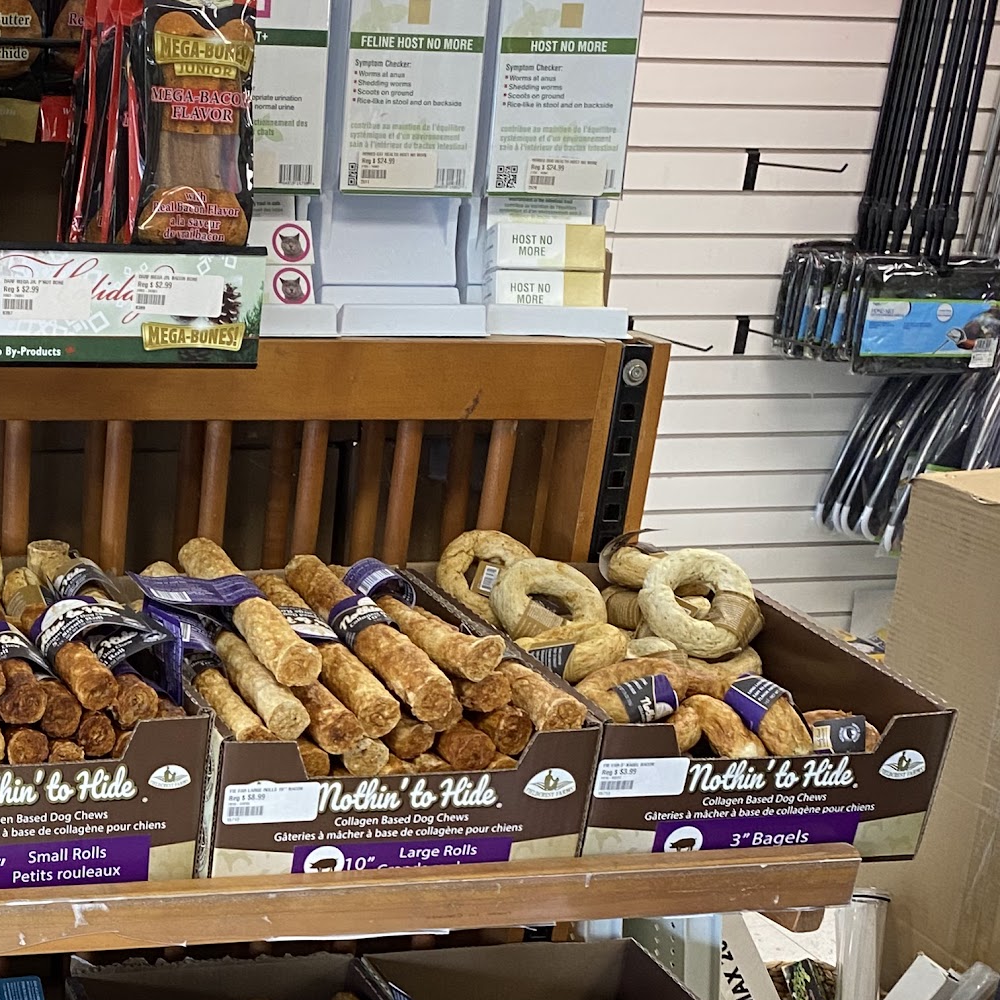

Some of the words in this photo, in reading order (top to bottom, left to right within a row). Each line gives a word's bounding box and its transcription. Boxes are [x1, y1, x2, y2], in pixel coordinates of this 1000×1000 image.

[361, 35, 395, 48] FELINE
[398, 37, 424, 49] HOST
[426, 38, 441, 50] NO
[444, 39, 473, 50] MORE
[531, 41, 558, 52] HOST
[561, 41, 575, 52] NO
[578, 41, 608, 52] MORE
[178, 63, 233, 77] JUNIOR
[355, 59, 383, 68] Symptom
[385, 60, 412, 68] Checker:
[358, 79, 388, 88] Shedding
[358, 88, 379, 96] Scoots
[172, 106, 234, 122] FLAVOR
[512, 235, 537, 245] HOST
[540, 235, 553, 245] NO
[519, 246, 546, 256] MORE
[510, 283, 535, 293] HOST
[538, 284, 551, 293] NO
[517, 295, 544, 304] MORE
[148, 324, 239, 347] MEGA-BONES!
[6, 346, 61, 357] By-Products
[689, 759, 775, 792] Nothin'
[775, 759, 799, 788] to
[803, 756, 854, 787] Hide
[45, 771, 74, 803] to
[75, 765, 136, 801] Hide
[318, 777, 409, 812] Nothin'
[410, 778, 437, 808] to
[439, 774, 497, 807] Hide
[752, 830, 809, 846] Bagels
[28, 848, 68, 864] Small
[72, 846, 107, 860] Rolls
[399, 846, 440, 860] Large
[443, 844, 477, 856] Rolls
[13, 869, 53, 884] Petits
[57, 865, 121, 880] rouleaux
